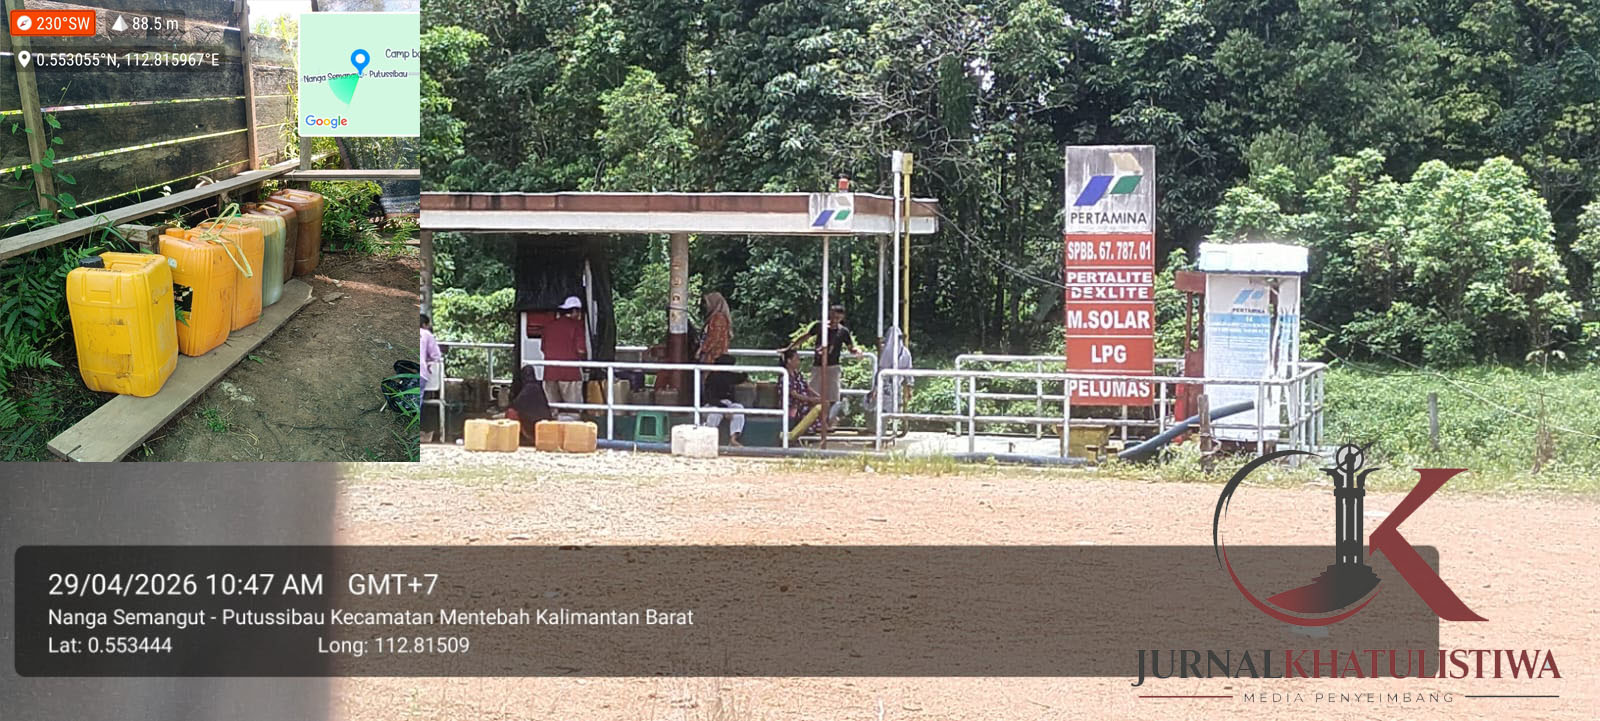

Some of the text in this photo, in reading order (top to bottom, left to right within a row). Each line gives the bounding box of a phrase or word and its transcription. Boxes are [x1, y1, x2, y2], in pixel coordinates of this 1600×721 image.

[1070, 211, 1147, 225] PERTAMINA
[1067, 240, 1152, 261] SPBB. 67. 787. 01
[1066, 271, 1153, 284] PERTALITE
[1071, 286, 1149, 300] DEXLITE
[1067, 309, 1150, 330] M.SOLAR
[1091, 344, 1127, 364] LPG
[1069, 379, 1151, 398] PELUMAS
